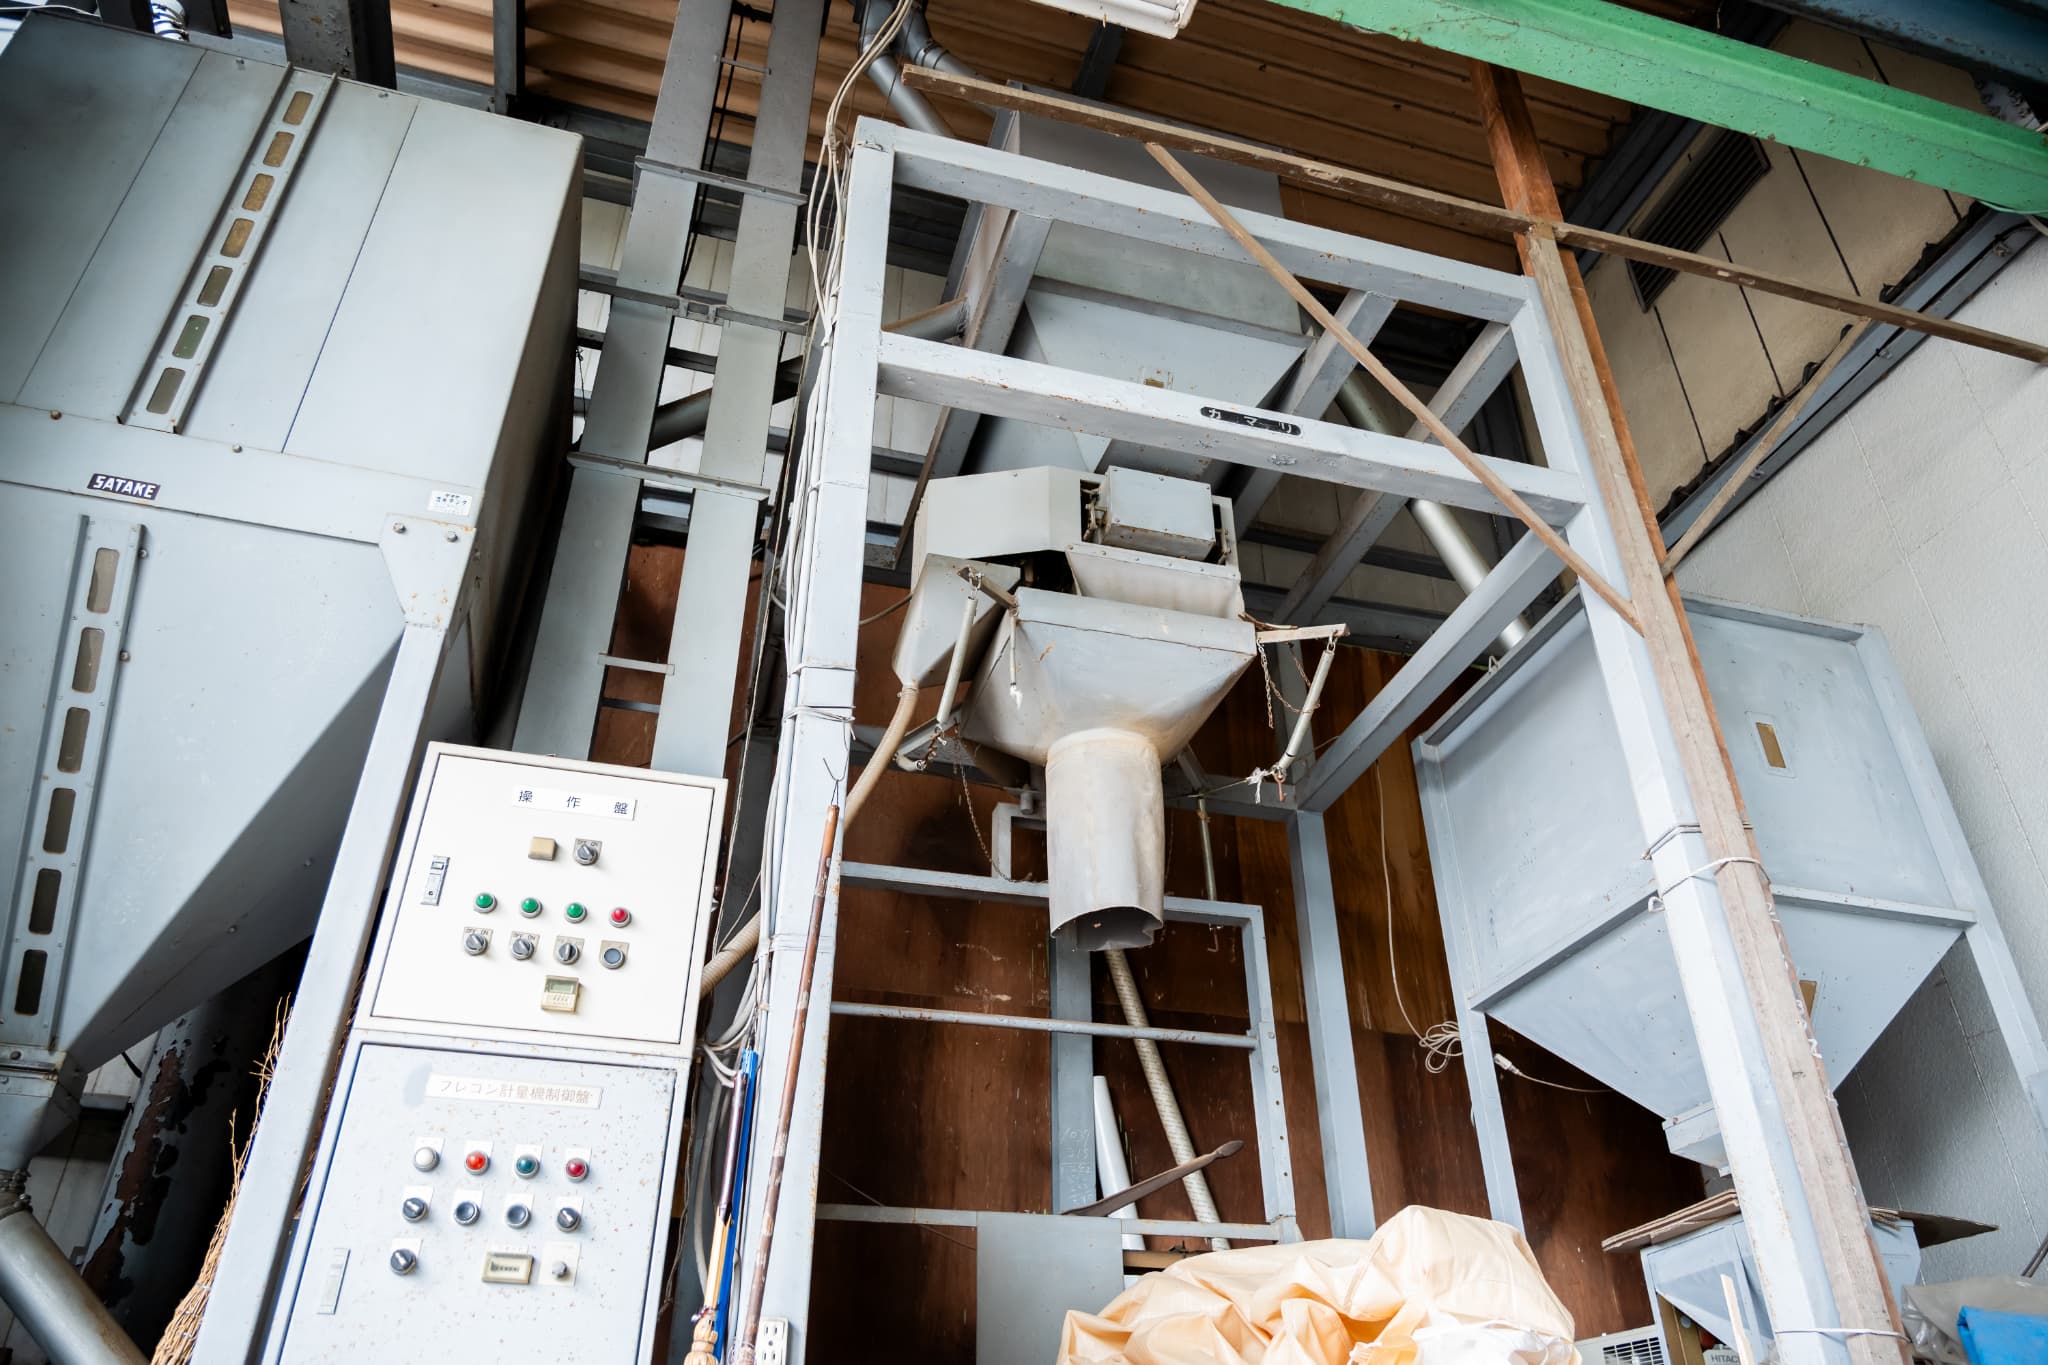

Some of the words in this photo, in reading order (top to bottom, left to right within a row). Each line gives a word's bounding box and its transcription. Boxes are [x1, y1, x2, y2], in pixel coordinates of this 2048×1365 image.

[93, 475, 156, 498] SATAKE
[518, 790, 629, 815] 操作盤
[440, 1079, 590, 1104] フレコン計量機制御盤
[1711, 1354, 1739, 1364] HITAC
